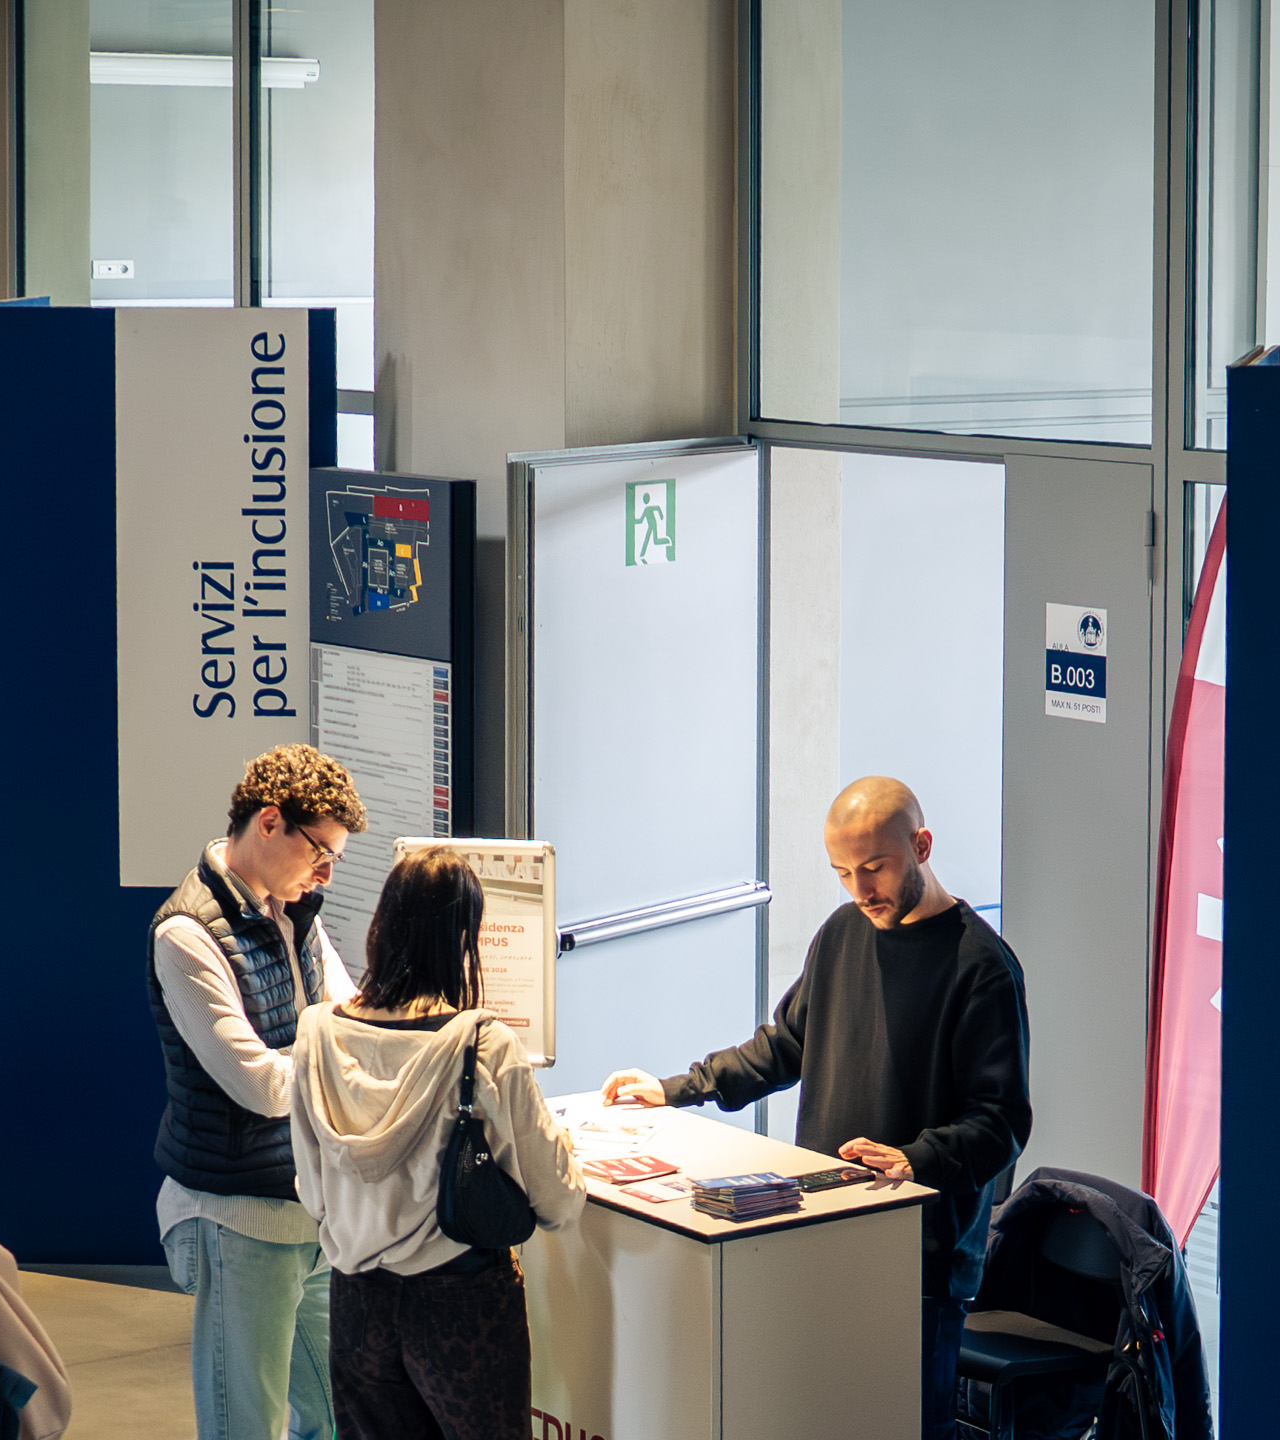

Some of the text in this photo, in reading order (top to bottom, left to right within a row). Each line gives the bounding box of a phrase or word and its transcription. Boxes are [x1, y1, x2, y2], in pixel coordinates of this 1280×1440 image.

[192, 560, 237, 719] Servizi
[250, 634, 297, 718] per
[1051, 664, 1095, 689] B.003
[1051, 699, 1065, 710] MAX
[1074, 703, 1081, 711] 51
[1082, 703, 1101, 714] POSTI
[479, 921, 525, 933] sidenza
